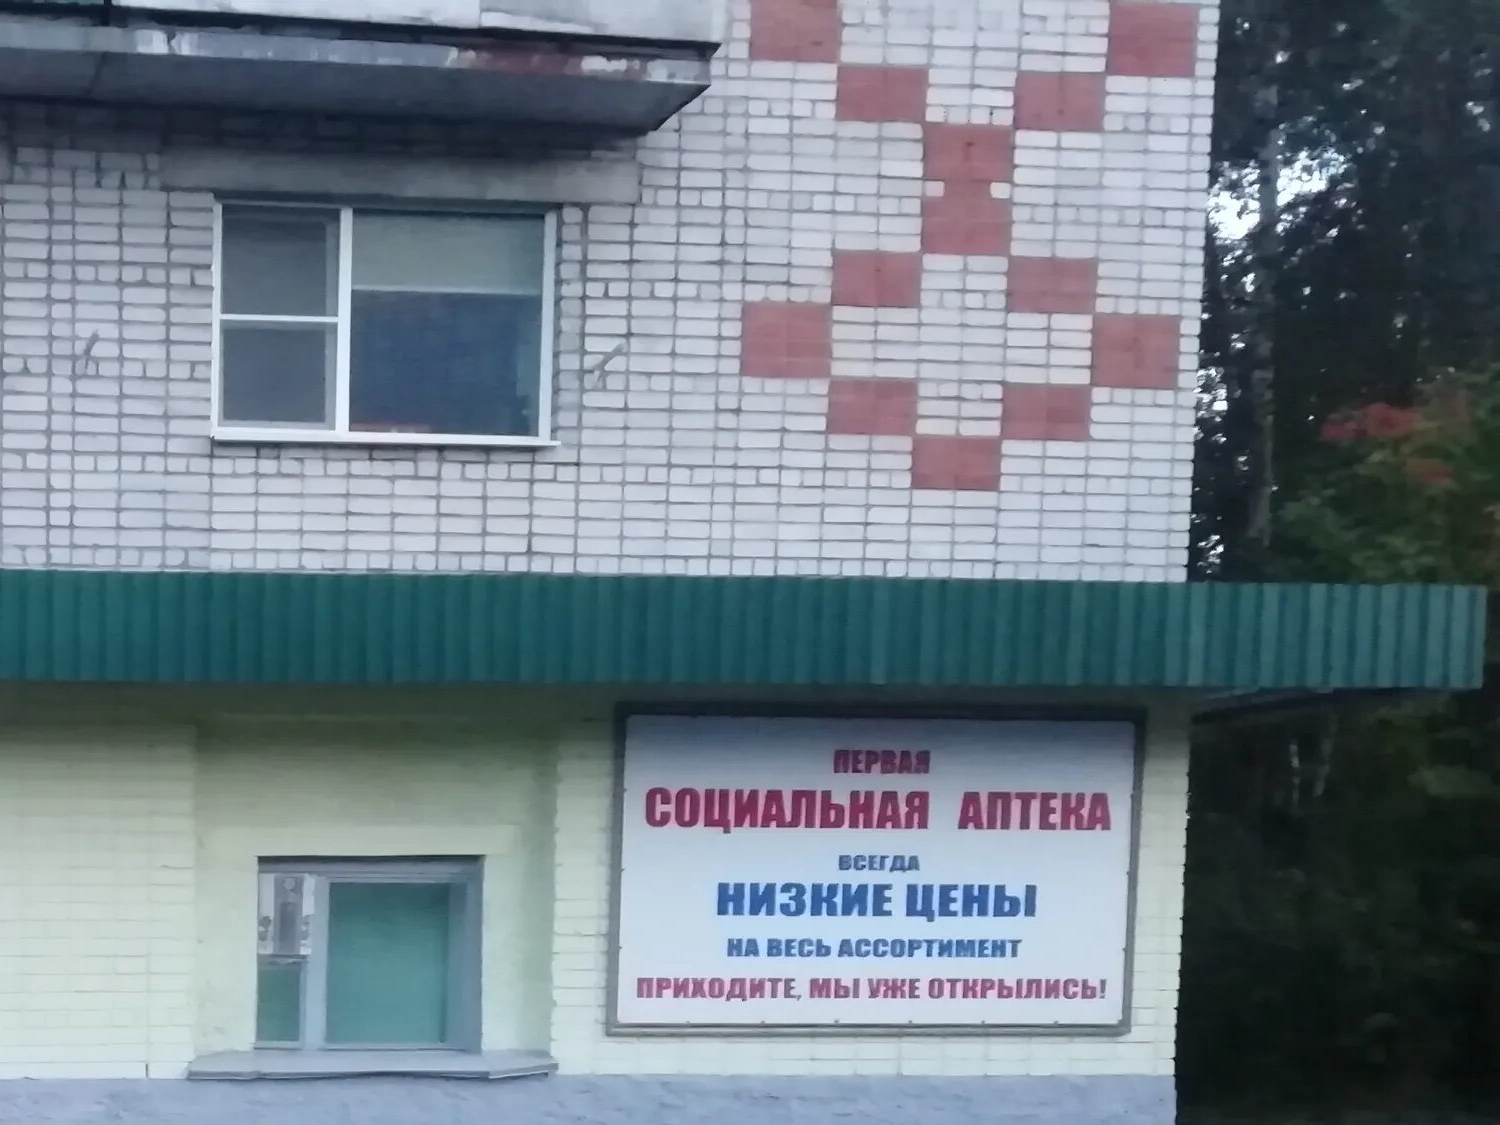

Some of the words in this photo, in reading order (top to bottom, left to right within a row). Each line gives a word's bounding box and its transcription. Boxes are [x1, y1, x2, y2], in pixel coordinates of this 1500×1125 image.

[833, 749, 931, 775] ПЕРВАЯ
[644, 787, 930, 834] СОЦИАЛЬНАЯ
[957, 791, 1112, 831] АПТЕКА
[838, 854, 920, 872] ВСЕГДА
[716, 881, 893, 917] НИЗКИЕ
[905, 884, 1037, 922] ЦЕНЫ
[726, 938, 760, 958] НА
[766, 939, 831, 958] ВЕСЬ
[837, 938, 1023, 958] АССОРТИМЕНТ
[636, 977, 802, 1001] ПРИХОДИТЕ,
[808, 978, 860, 999] МЫ
[867, 978, 920, 999] УЖЕ
[928, 978, 1108, 1000] ОТКРЫЛИСЬ!
